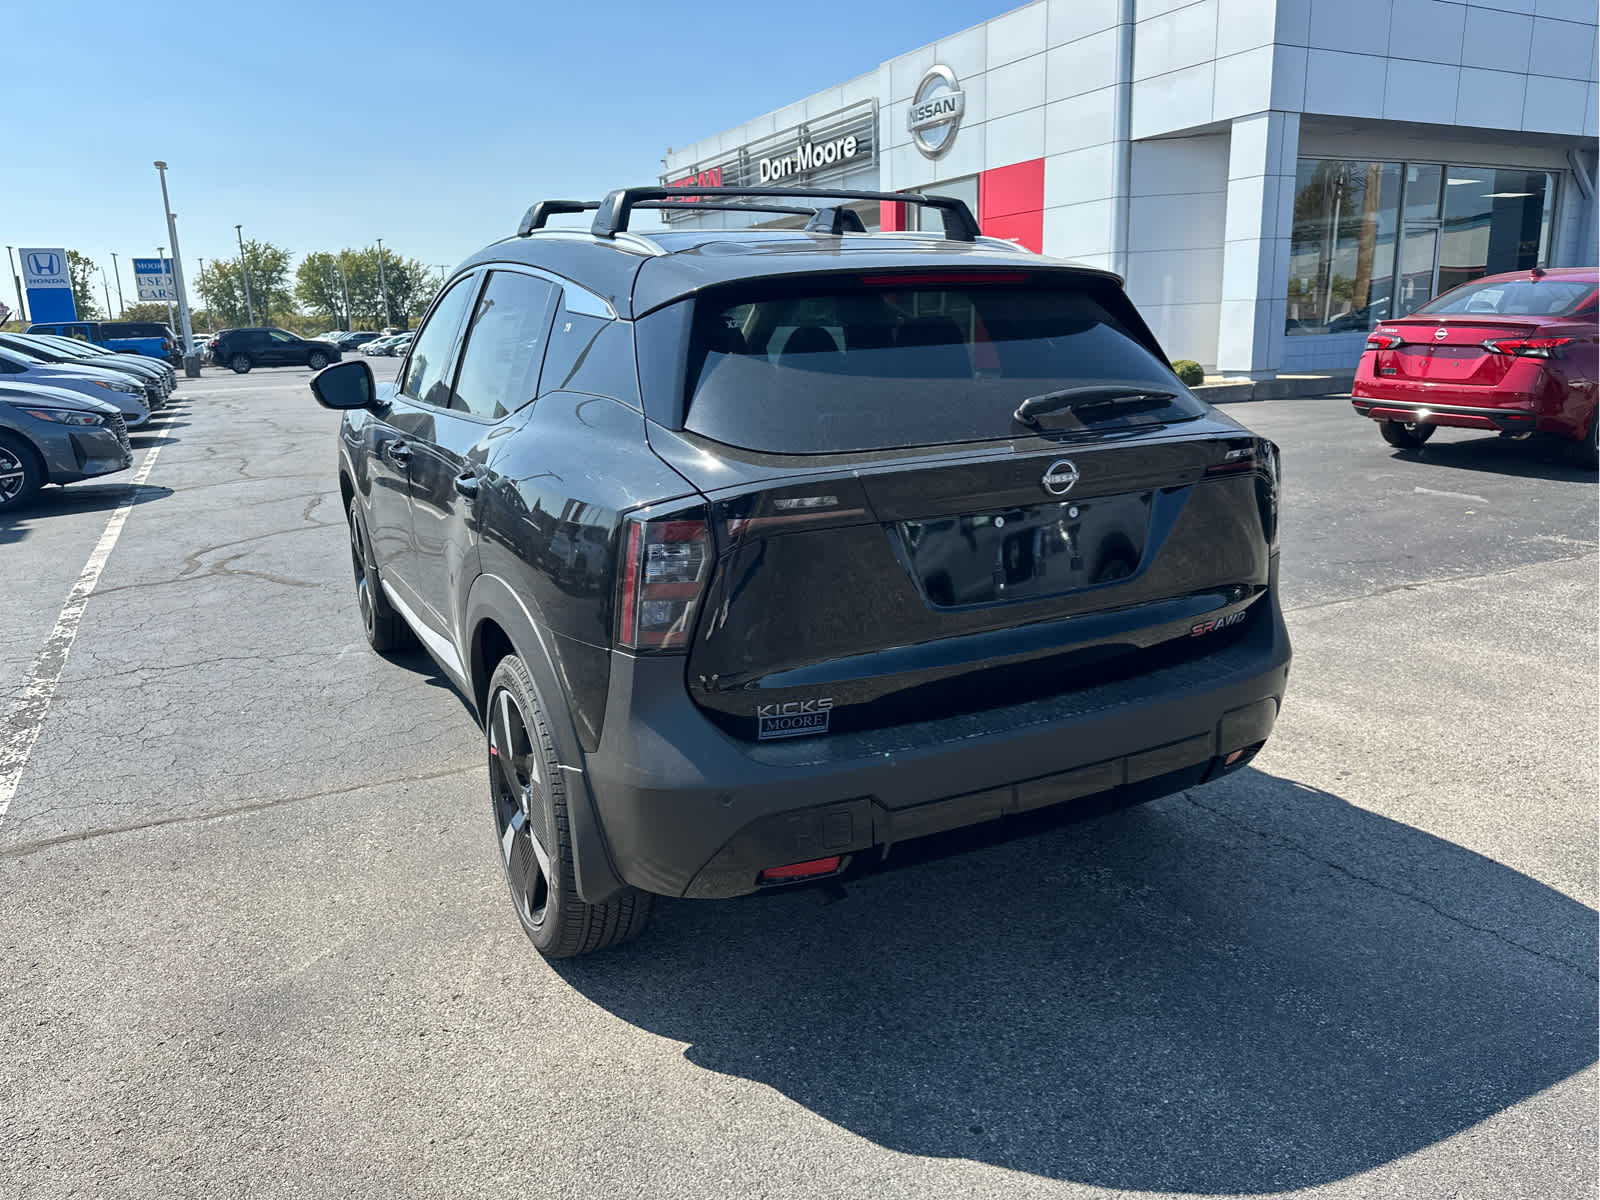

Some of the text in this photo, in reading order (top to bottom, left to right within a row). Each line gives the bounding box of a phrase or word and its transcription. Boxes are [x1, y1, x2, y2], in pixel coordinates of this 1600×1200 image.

[910, 97, 956, 123] NISSAN
[759, 136, 857, 183] Don Moore
[139, 288, 176, 298] CARS
[757, 697, 833, 717] KICKS
[767, 714, 824, 731] MOORE
